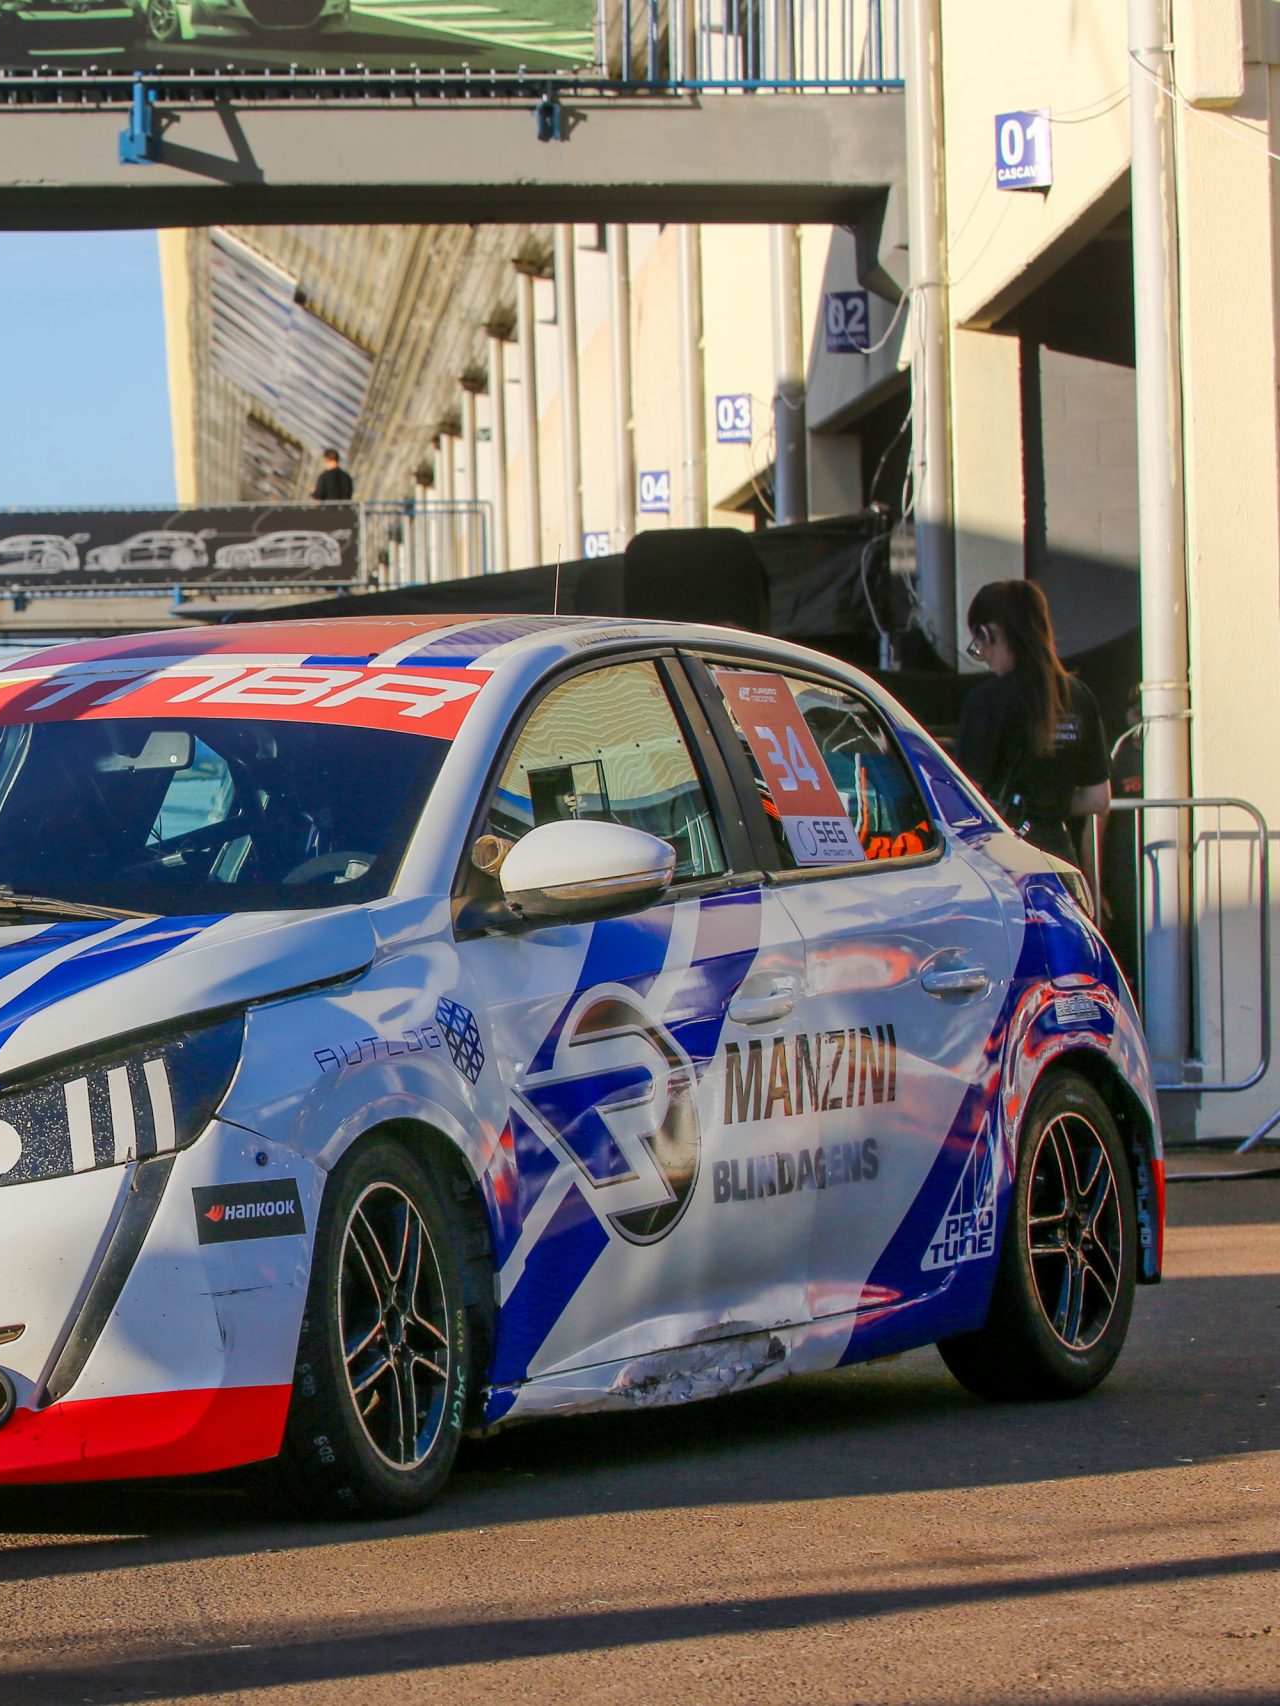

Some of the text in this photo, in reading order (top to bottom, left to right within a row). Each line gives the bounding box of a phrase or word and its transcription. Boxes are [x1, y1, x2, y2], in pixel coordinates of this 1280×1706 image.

[1000, 116, 1048, 166] 01
[998, 165, 1046, 182] CASCAV
[828, 297, 866, 335] 02
[718, 397, 751, 430] 03
[641, 473, 669, 501] 04
[585, 533, 609, 559] 05
[753, 726, 821, 791] 34
[812, 821, 848, 844] SEG
[314, 1026, 442, 1073] AUTLOG
[723, 1023, 897, 1125] MANZINI
[711, 1137, 880, 1204] BLINDAGENS
[945, 1210, 994, 1240] PRO
[930, 1231, 993, 1264] TUNE
